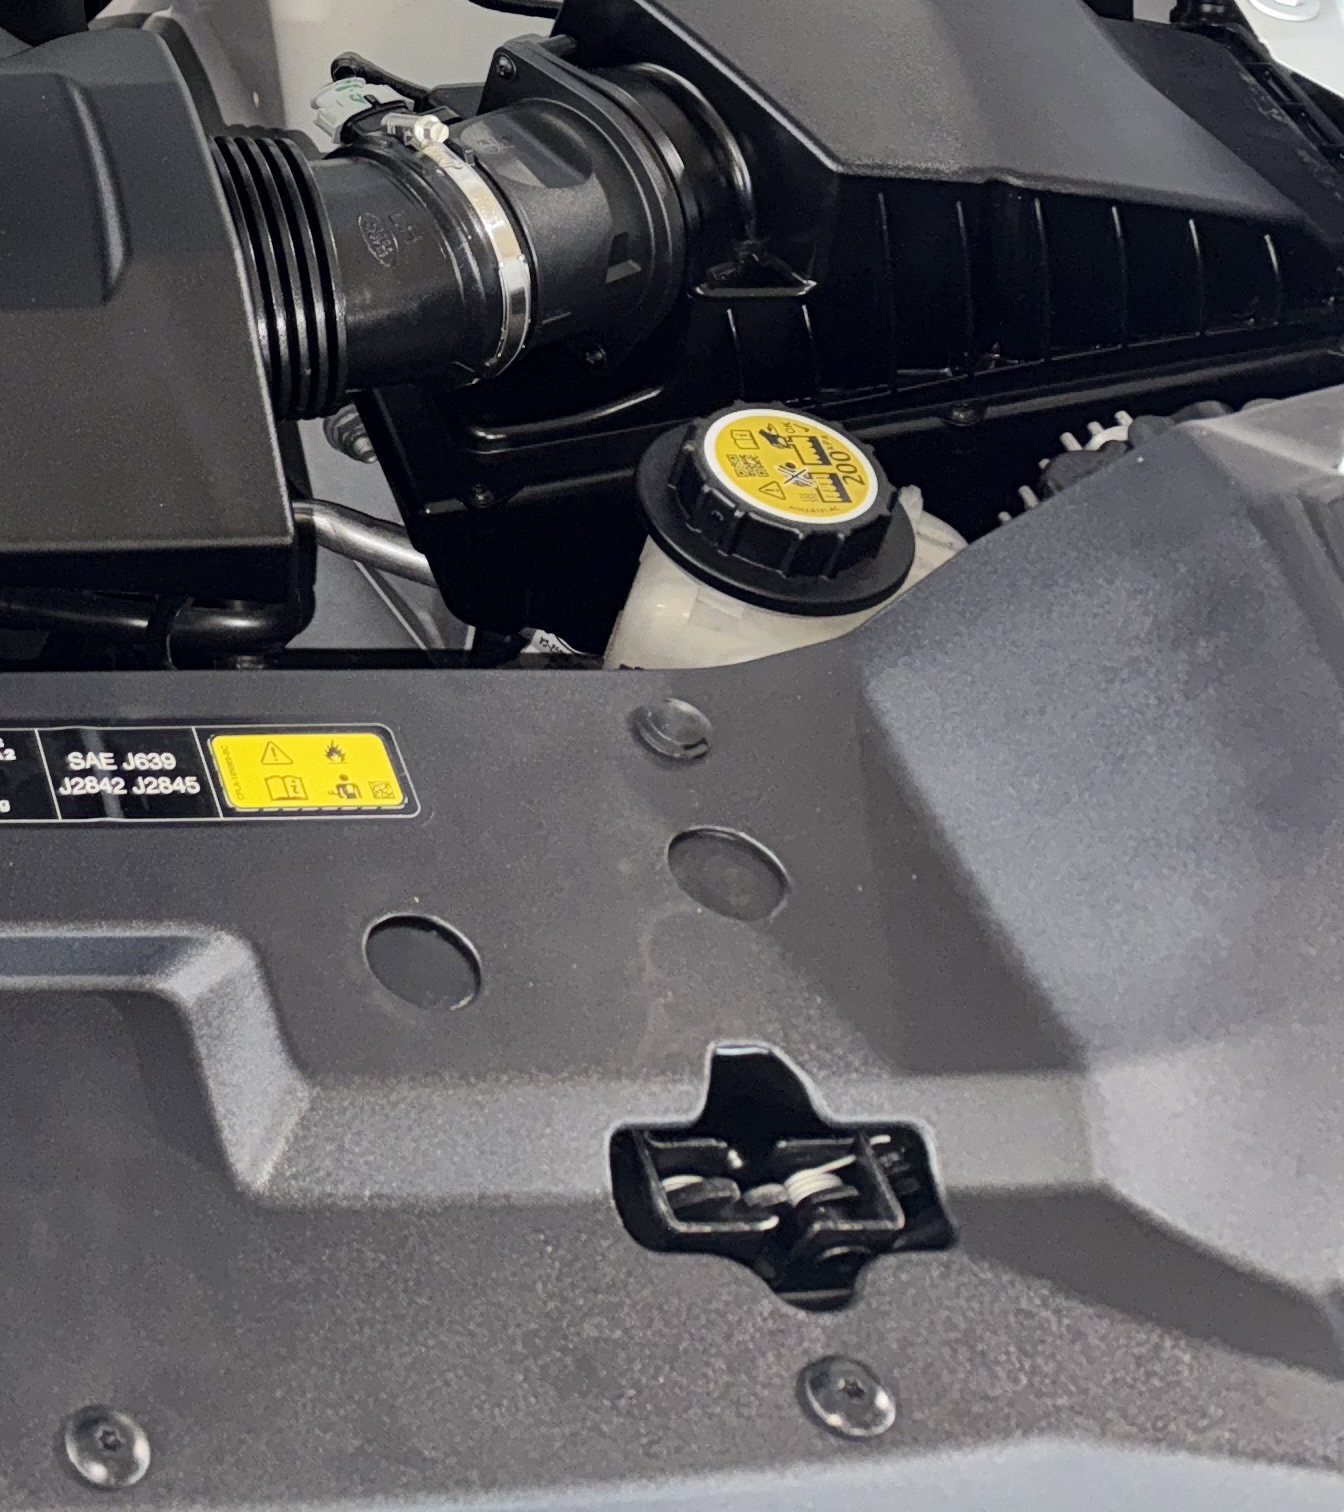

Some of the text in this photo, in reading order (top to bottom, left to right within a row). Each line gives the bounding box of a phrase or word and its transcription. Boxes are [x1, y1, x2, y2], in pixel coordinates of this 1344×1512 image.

[829, 450, 866, 486] 200
[66, 751, 177, 771] SAE J639
[59, 775, 201, 795] J2842 J2845
